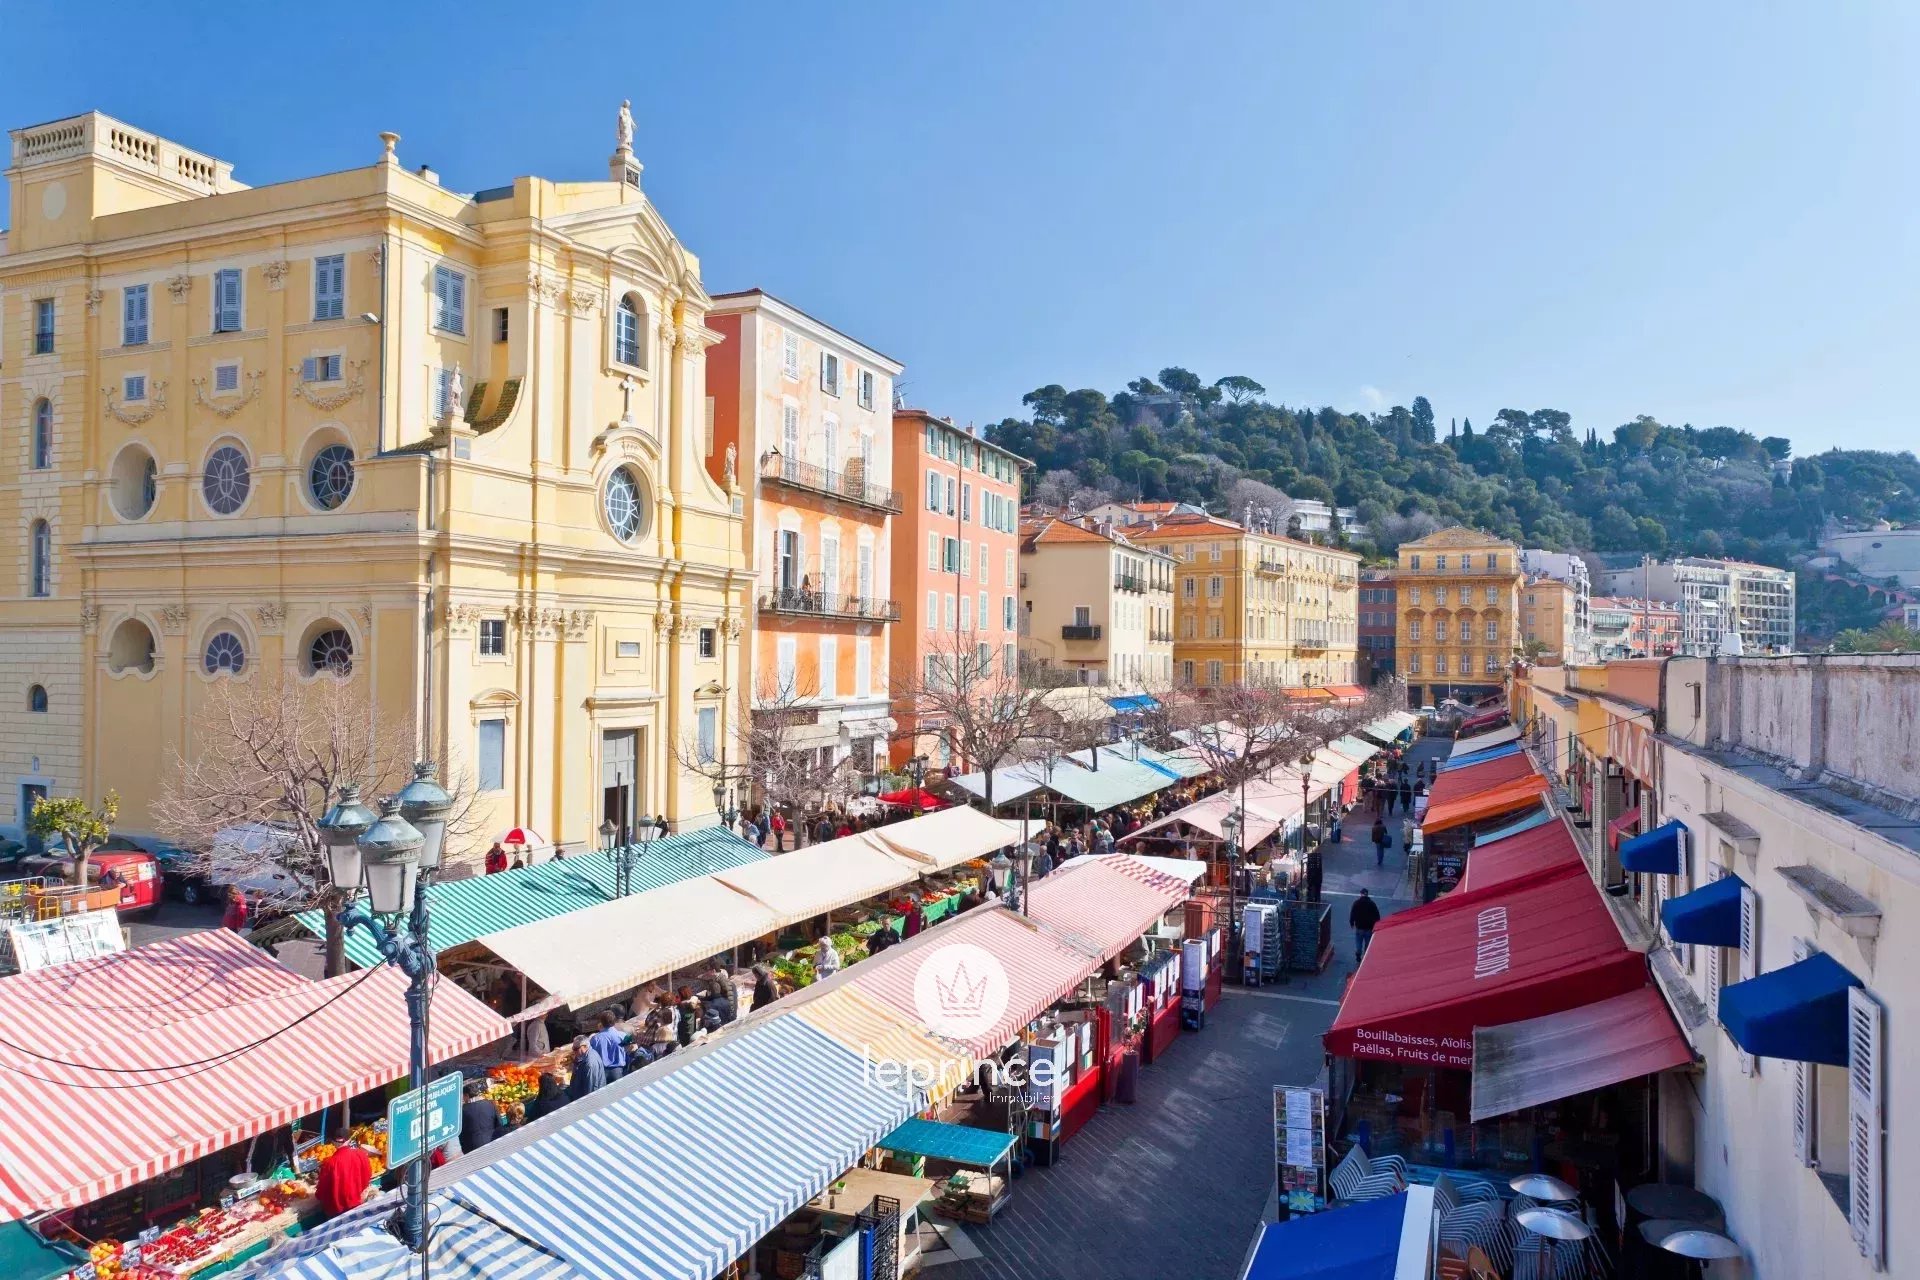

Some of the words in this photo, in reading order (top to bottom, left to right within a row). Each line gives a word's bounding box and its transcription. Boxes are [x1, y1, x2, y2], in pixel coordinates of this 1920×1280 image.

[1477, 906, 1508, 938] CHEZ
[1474, 933, 1511, 980] FREDDY
[1357, 1028, 1438, 1047] Bouillabaisses,
[1441, 1036, 1472, 1050] Aïolis
[1352, 1042, 1394, 1058] Paëllas,
[1397, 1047, 1429, 1061] Fruits
[1431, 1051, 1446, 1062] de
[1449, 1055, 1473, 1065] mer
[416, 1099, 438, 1116] SAEYA
